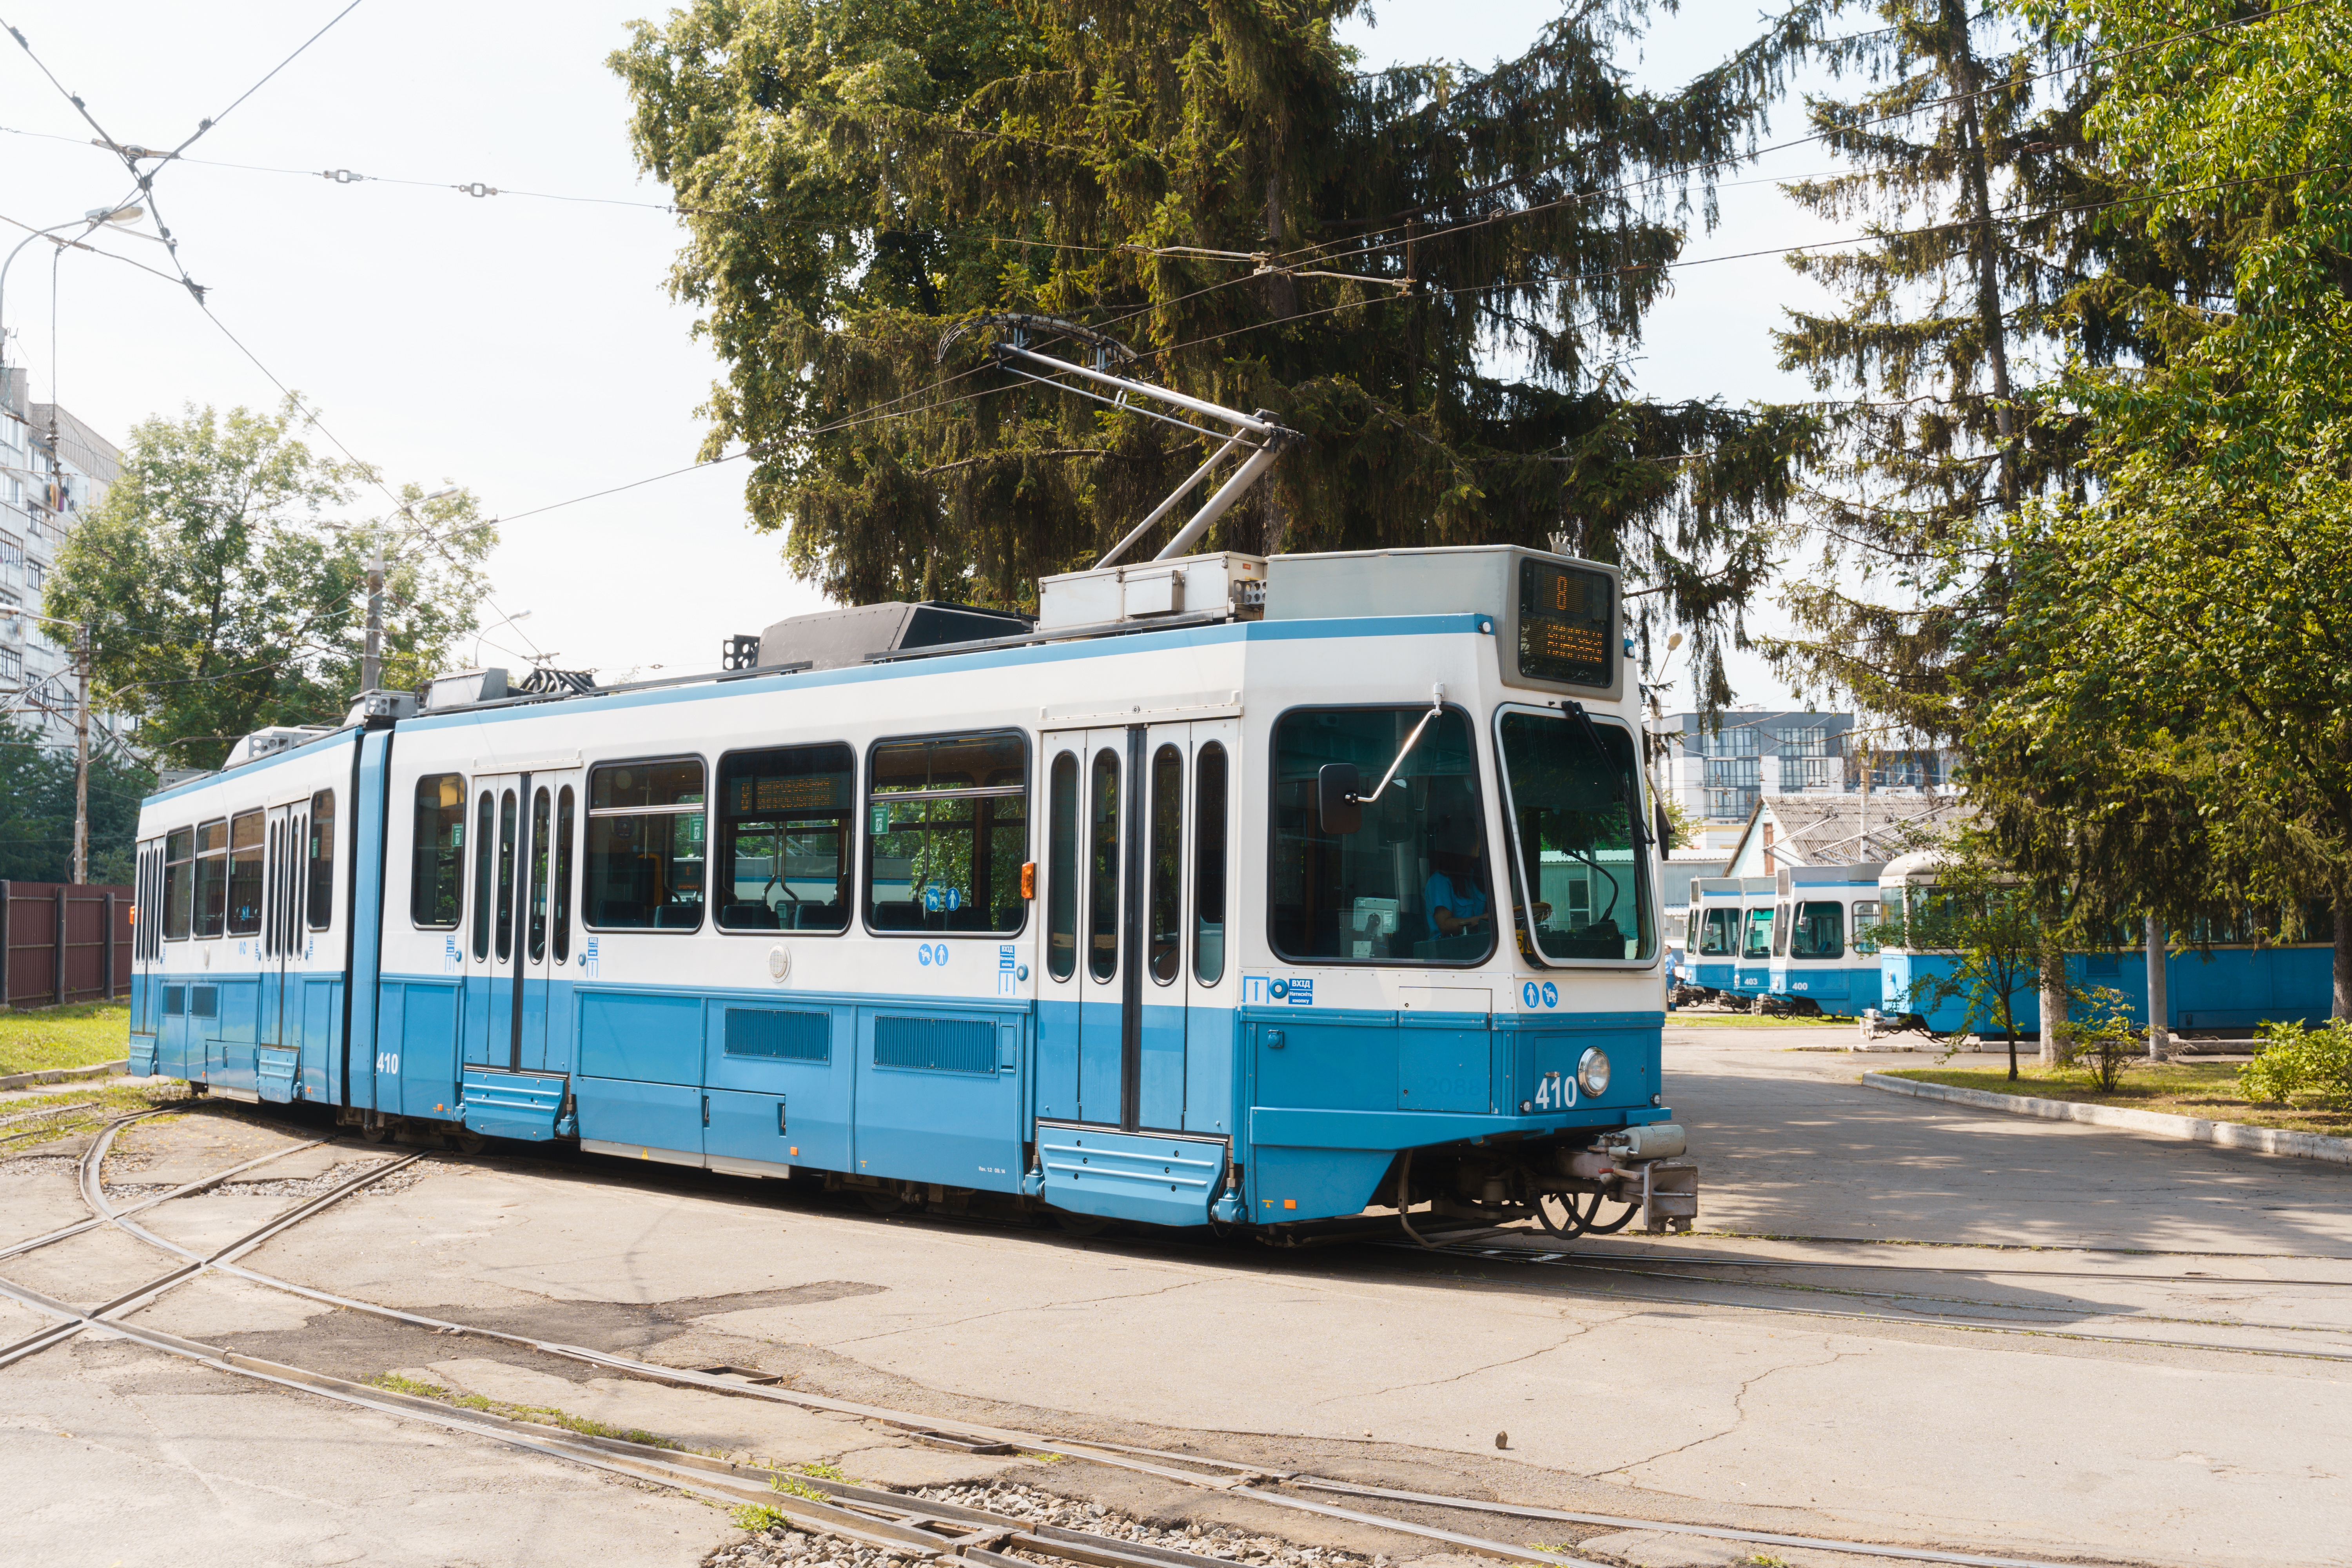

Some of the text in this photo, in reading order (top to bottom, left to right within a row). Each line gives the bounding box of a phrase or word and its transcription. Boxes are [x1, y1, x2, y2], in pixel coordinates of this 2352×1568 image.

[1556, 576, 1567, 610] 8
[1001, 946, 1013, 954] ВХІД
[1292, 980, 1310, 989] ВХІД
[1792, 982, 1808, 991] 400
[376, 1052, 399, 1074] 410
[1425, 1077, 1481, 1096] 2088
[1535, 1076, 1577, 1109] 410
